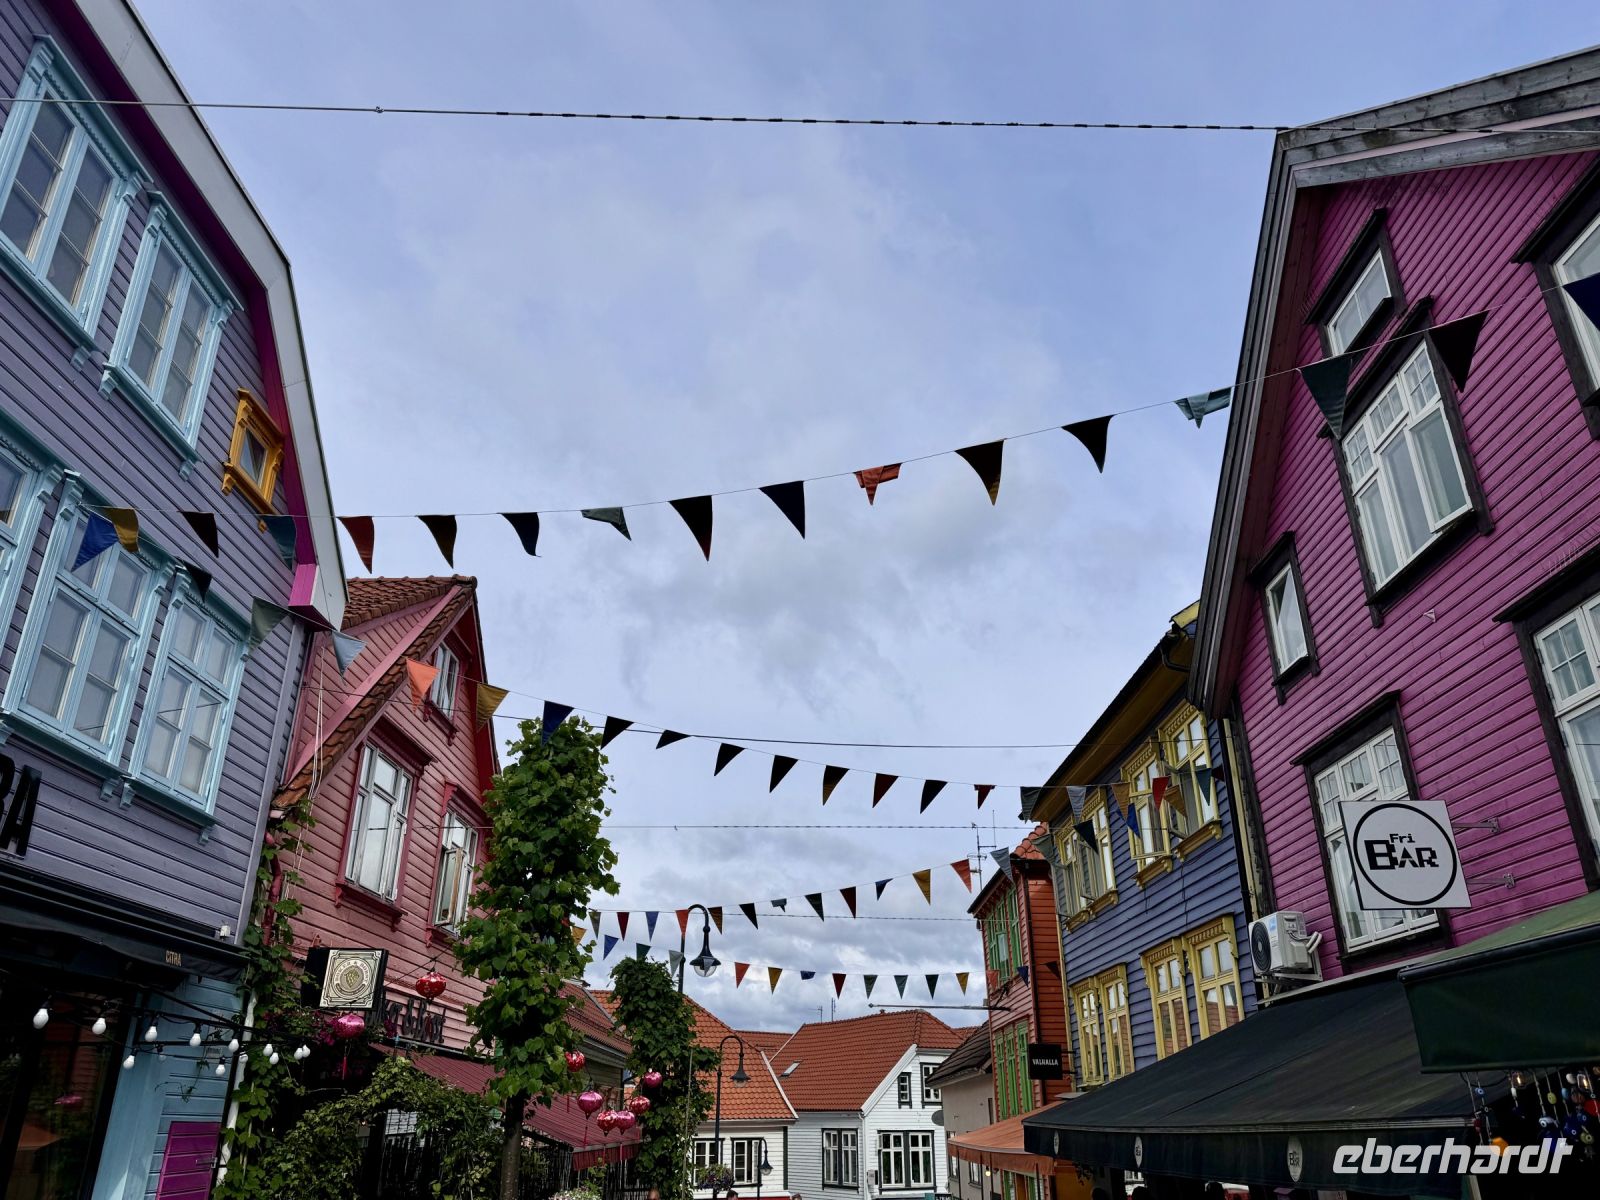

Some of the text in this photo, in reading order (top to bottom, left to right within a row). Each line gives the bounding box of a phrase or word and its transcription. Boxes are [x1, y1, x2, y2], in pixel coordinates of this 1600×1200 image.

[1389, 833, 1415, 843] Fri
[1364, 840, 1439, 870] BAR
[165, 950, 182, 967] CITRA
[1032, 1058, 1058, 1066] VALHALLA
